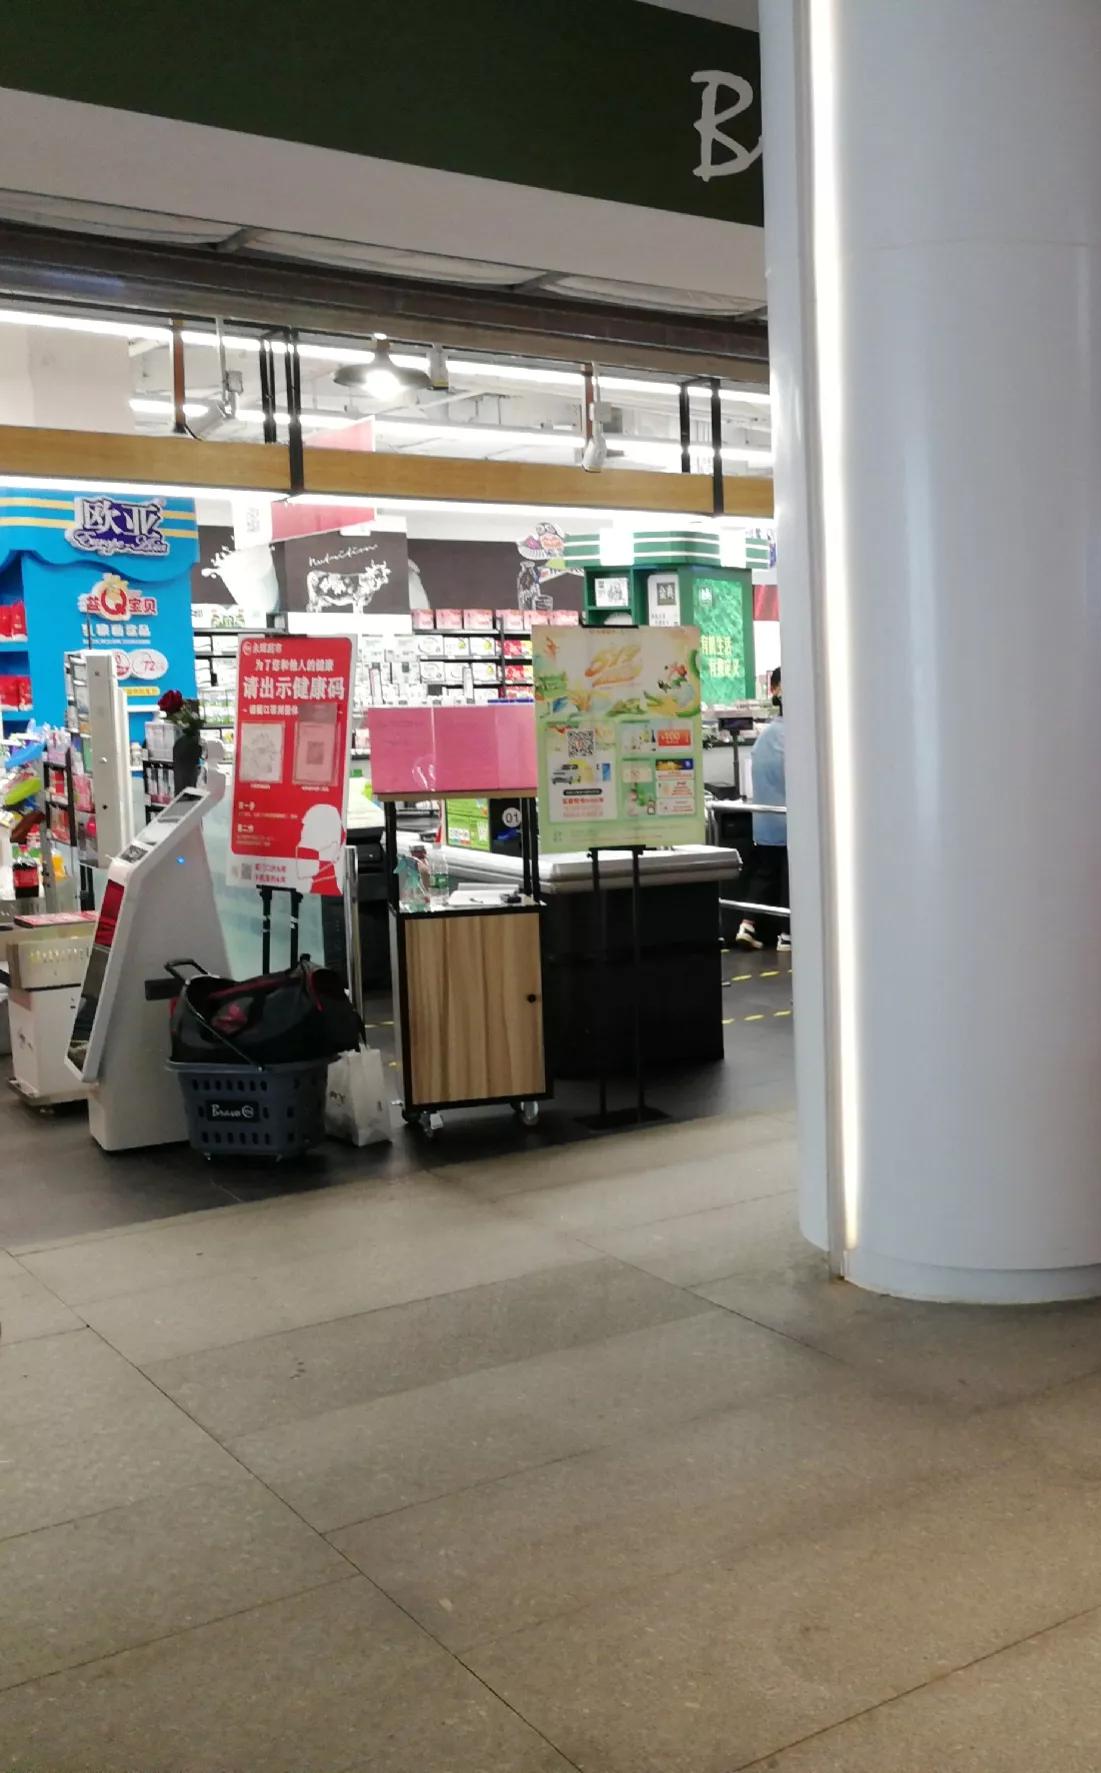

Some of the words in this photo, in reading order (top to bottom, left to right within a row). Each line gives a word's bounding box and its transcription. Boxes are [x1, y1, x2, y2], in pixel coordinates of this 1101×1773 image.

[690, 69, 763, 182] B
[82, 499, 161, 537] 欧亚
[243, 676, 345, 700] 请出示健康码
